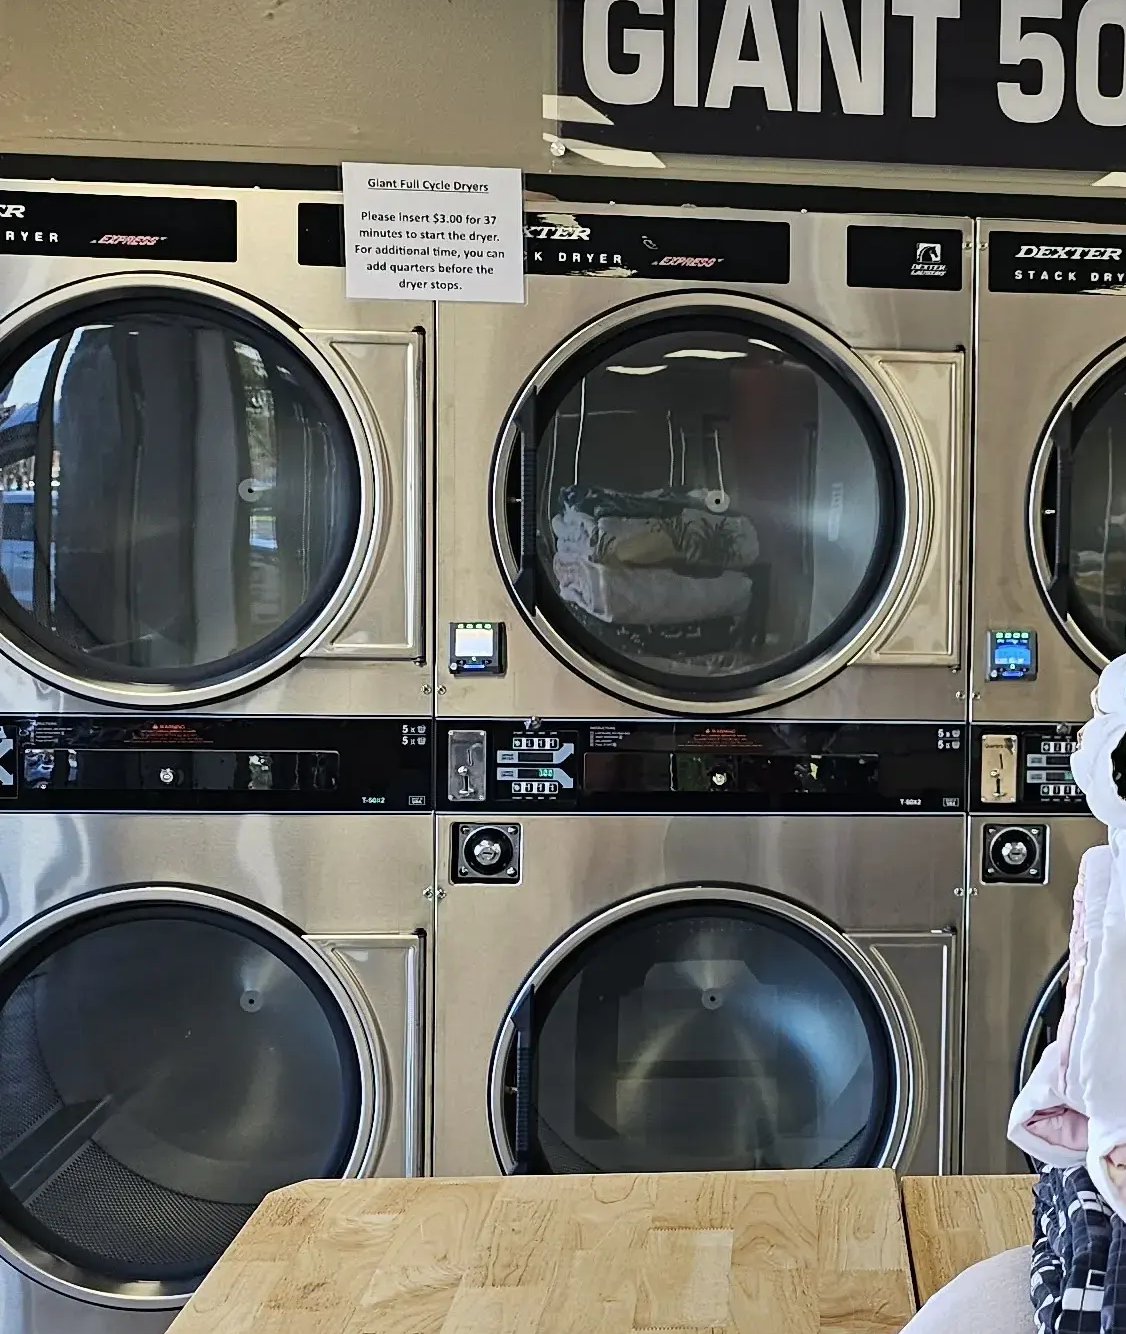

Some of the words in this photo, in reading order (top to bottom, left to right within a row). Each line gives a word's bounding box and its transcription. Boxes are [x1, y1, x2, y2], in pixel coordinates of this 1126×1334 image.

[367, 178, 397, 189] Giant
[400, 179, 420, 190] Full
[423, 180, 451, 191] Cycle
[453, 181, 489, 192] Dryers
[361, 211, 396, 222] Please
[433, 213, 463, 224] $3.00
[466, 214, 481, 224] for
[484, 215, 497, 225] 37
[5, 230, 59, 243] RYER
[359, 227, 403, 238] minutes
[406, 229, 417, 239] to
[420, 230, 445, 240] start
[448, 230, 466, 240] the
[469, 231, 500, 243] dryer.
[523, 225, 591, 240] XTER
[355, 244, 372, 254] For
[375, 245, 430, 256] additional
[433, 247, 461, 258] time,
[464, 250, 484, 259] you
[486, 250, 505, 259] can
[558, 251, 622, 264] DRYER
[1015, 245, 1123, 260] DEXTER
[366, 261, 387, 271] add
[389, 263, 435, 274] quarters
[438, 263, 473, 274] before
[476, 264, 494, 275] the
[1014, 270, 1077, 281] STACK
[399, 279, 428, 290] dryer
[430, 280, 463, 291] stops.
[402, 724, 409, 733] 5
[402, 736, 409, 745] 5
